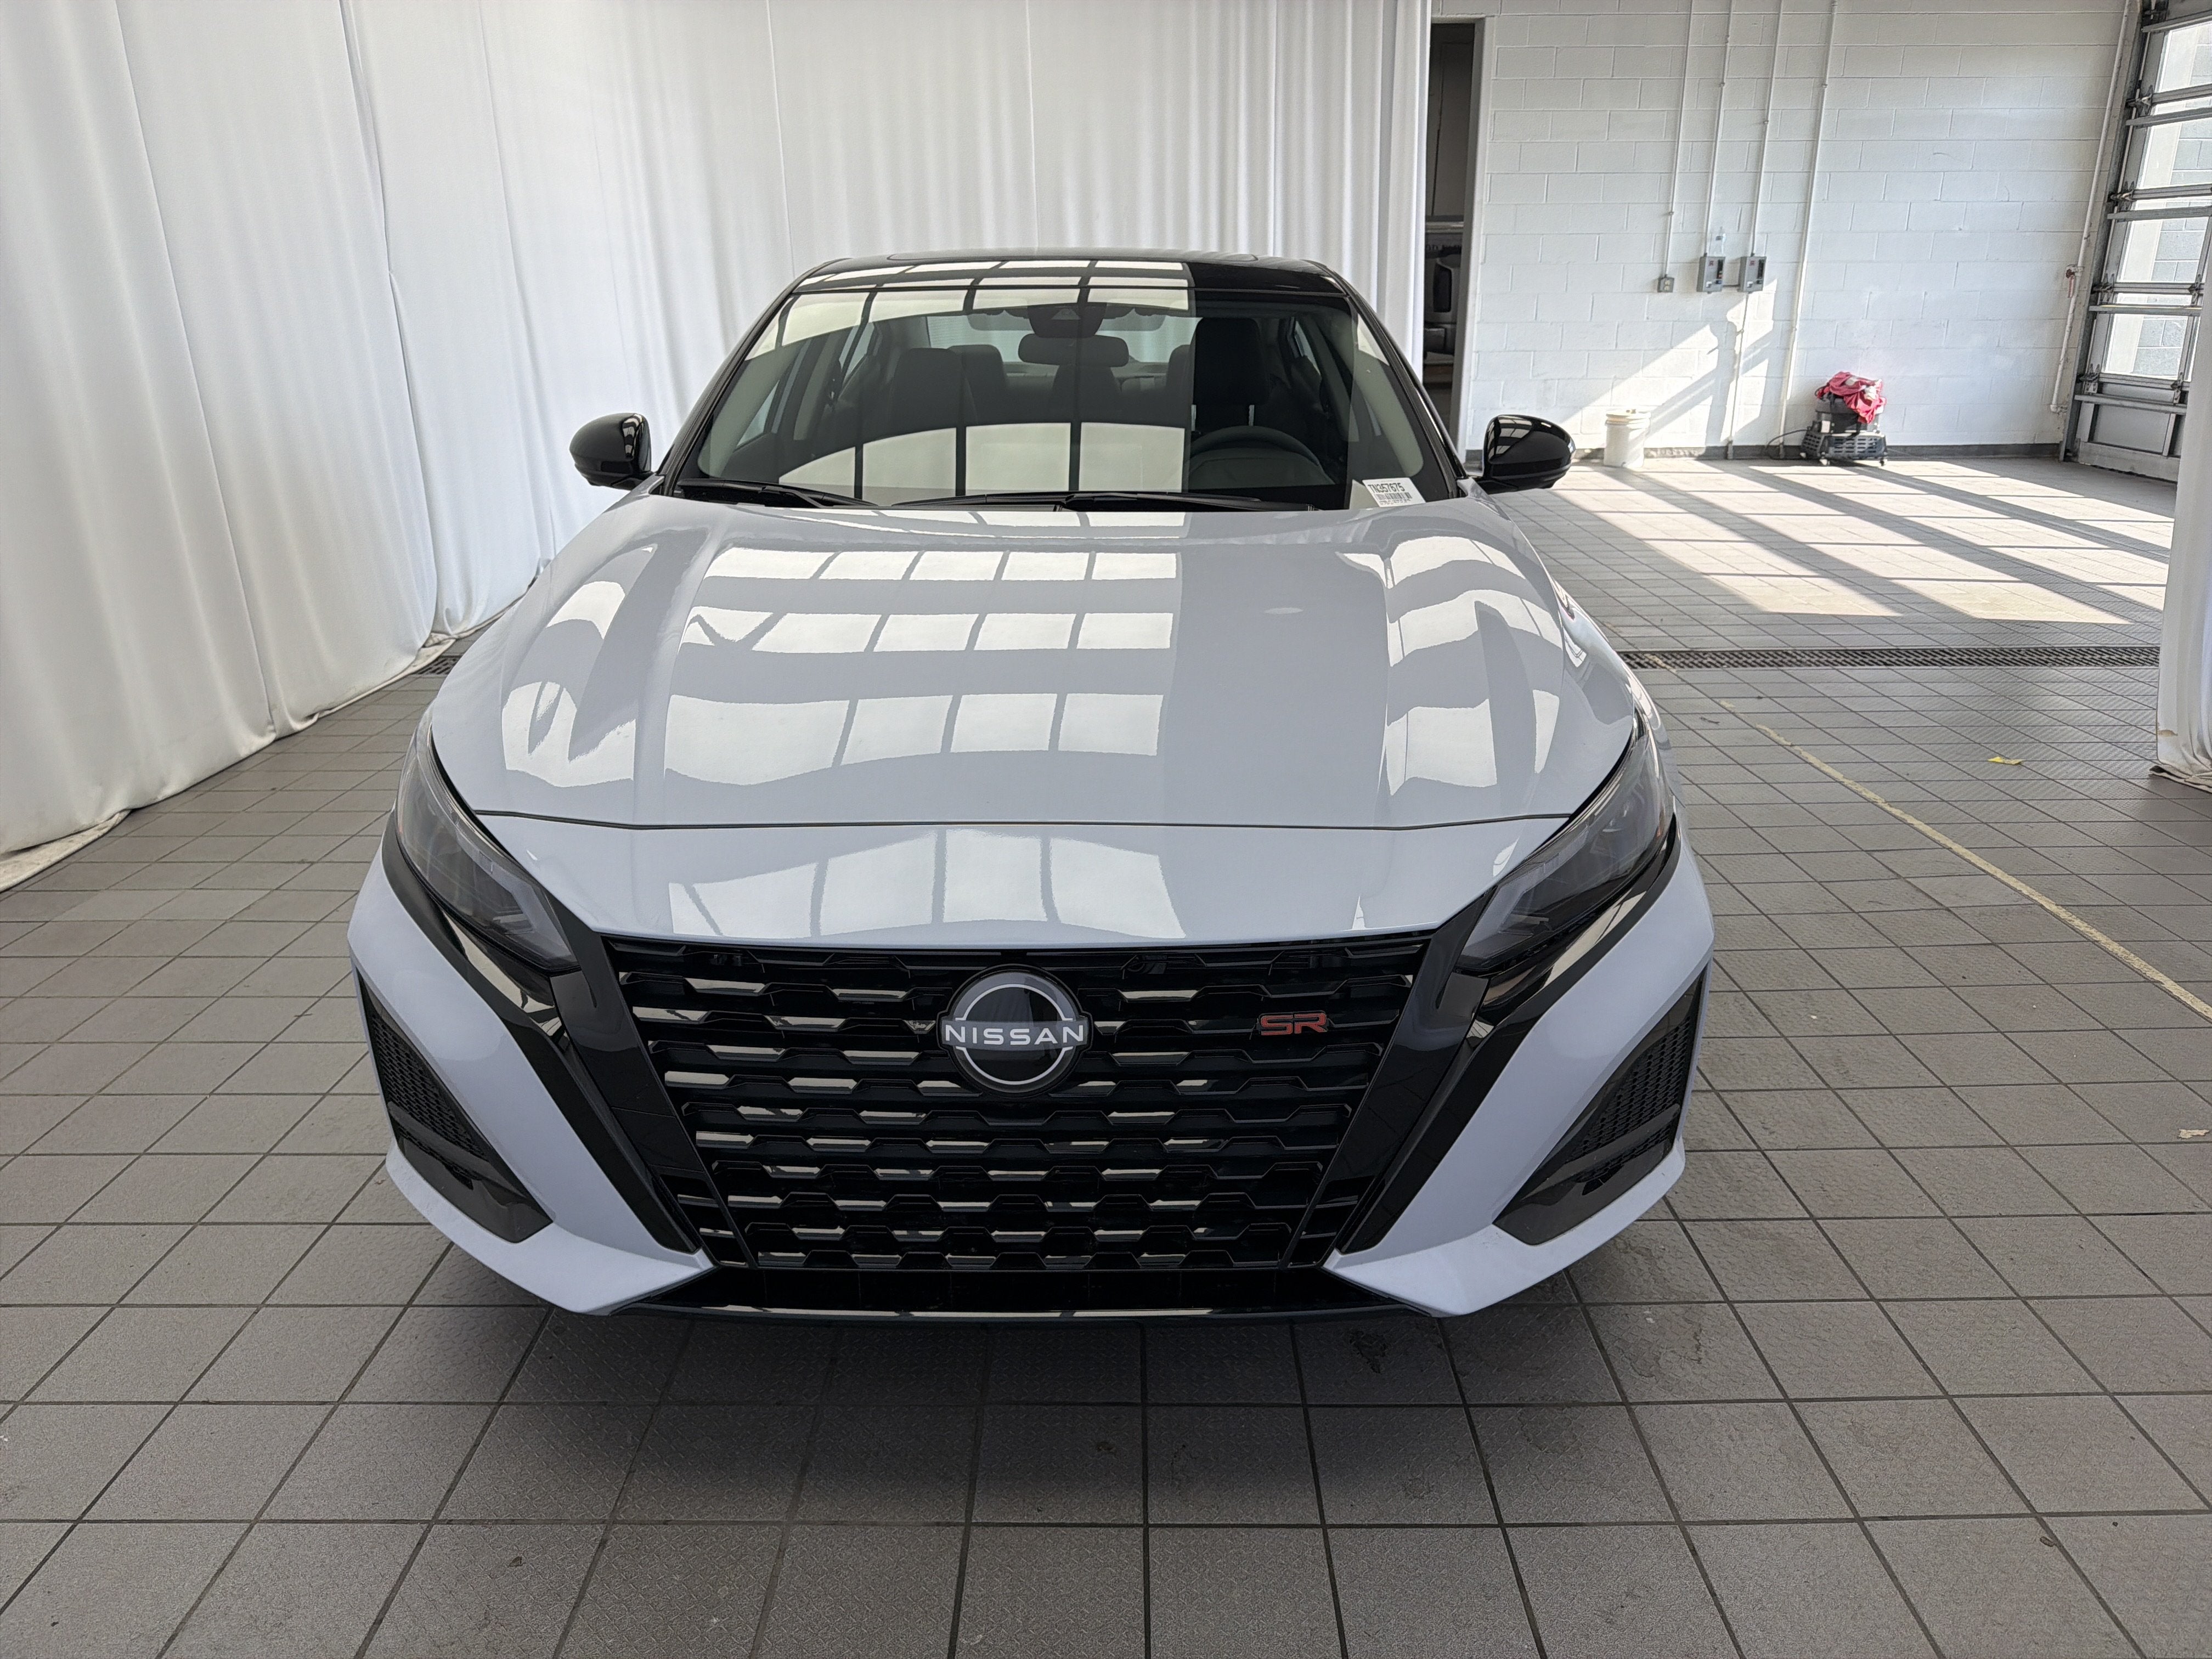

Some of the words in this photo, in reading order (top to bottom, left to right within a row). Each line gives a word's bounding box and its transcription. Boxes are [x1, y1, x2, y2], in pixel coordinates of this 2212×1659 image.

[1368, 483, 1405, 493] TN357675
[945, 1024, 1084, 1046] NISSAN
[1261, 1013, 1328, 1036] SR
